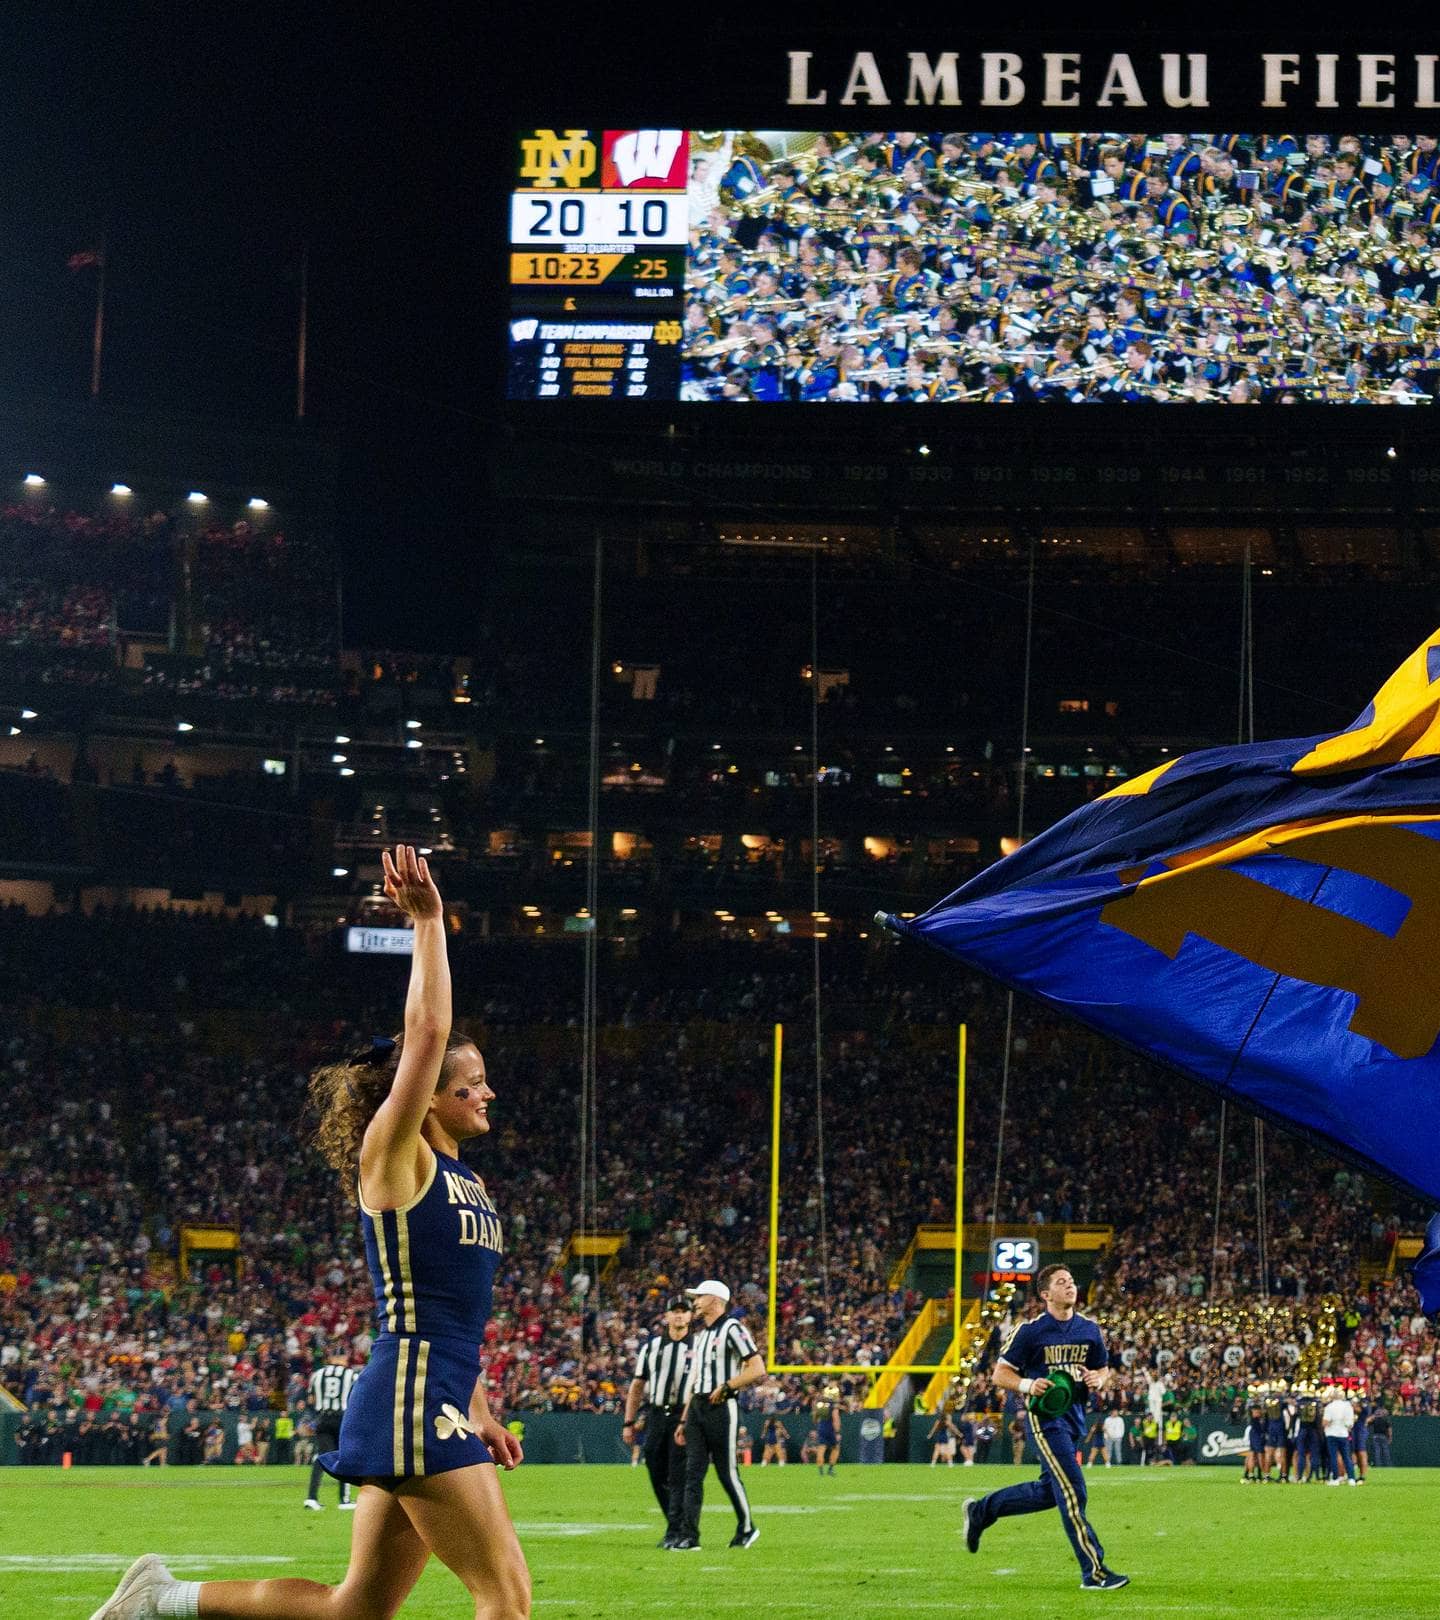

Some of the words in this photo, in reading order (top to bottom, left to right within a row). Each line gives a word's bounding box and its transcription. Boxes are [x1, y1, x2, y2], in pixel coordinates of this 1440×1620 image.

[786, 51, 1210, 108] LAMBEAU
[612, 129, 684, 188] W
[529, 198, 585, 238] 20
[617, 199, 668, 238] 10
[587, 244, 635, 254] QUARTER
[529, 257, 600, 280] 10:23
[635, 288, 658, 298] BALL
[658, 288, 674, 298] ON
[540, 325, 574, 339] TEAM
[572, 325, 654, 340] COMPARISON
[563, 343, 591, 354] FIRST
[591, 343, 625, 354] DOWNS
[564, 357, 592, 368] TOTAL
[592, 357, 624, 368] YARDS
[610, 459, 685, 478] WORLD
[692, 461, 813, 480] CHAMPIONS
[842, 464, 888, 482] 1929
[906, 465, 953, 482] 1930
[970, 465, 1011, 482] 1931
[1030, 465, 1076, 483] 1936
[1097, 465, 1142, 483] 1939
[1160, 466, 1206, 482] 1944
[1224, 466, 1266, 482] 1961
[1284, 466, 1331, 483] 1962
[1345, 466, 1392, 483] 1965
[996, 1242, 1033, 1270] 25
[1043, 1344, 1089, 1364] NOTRE
